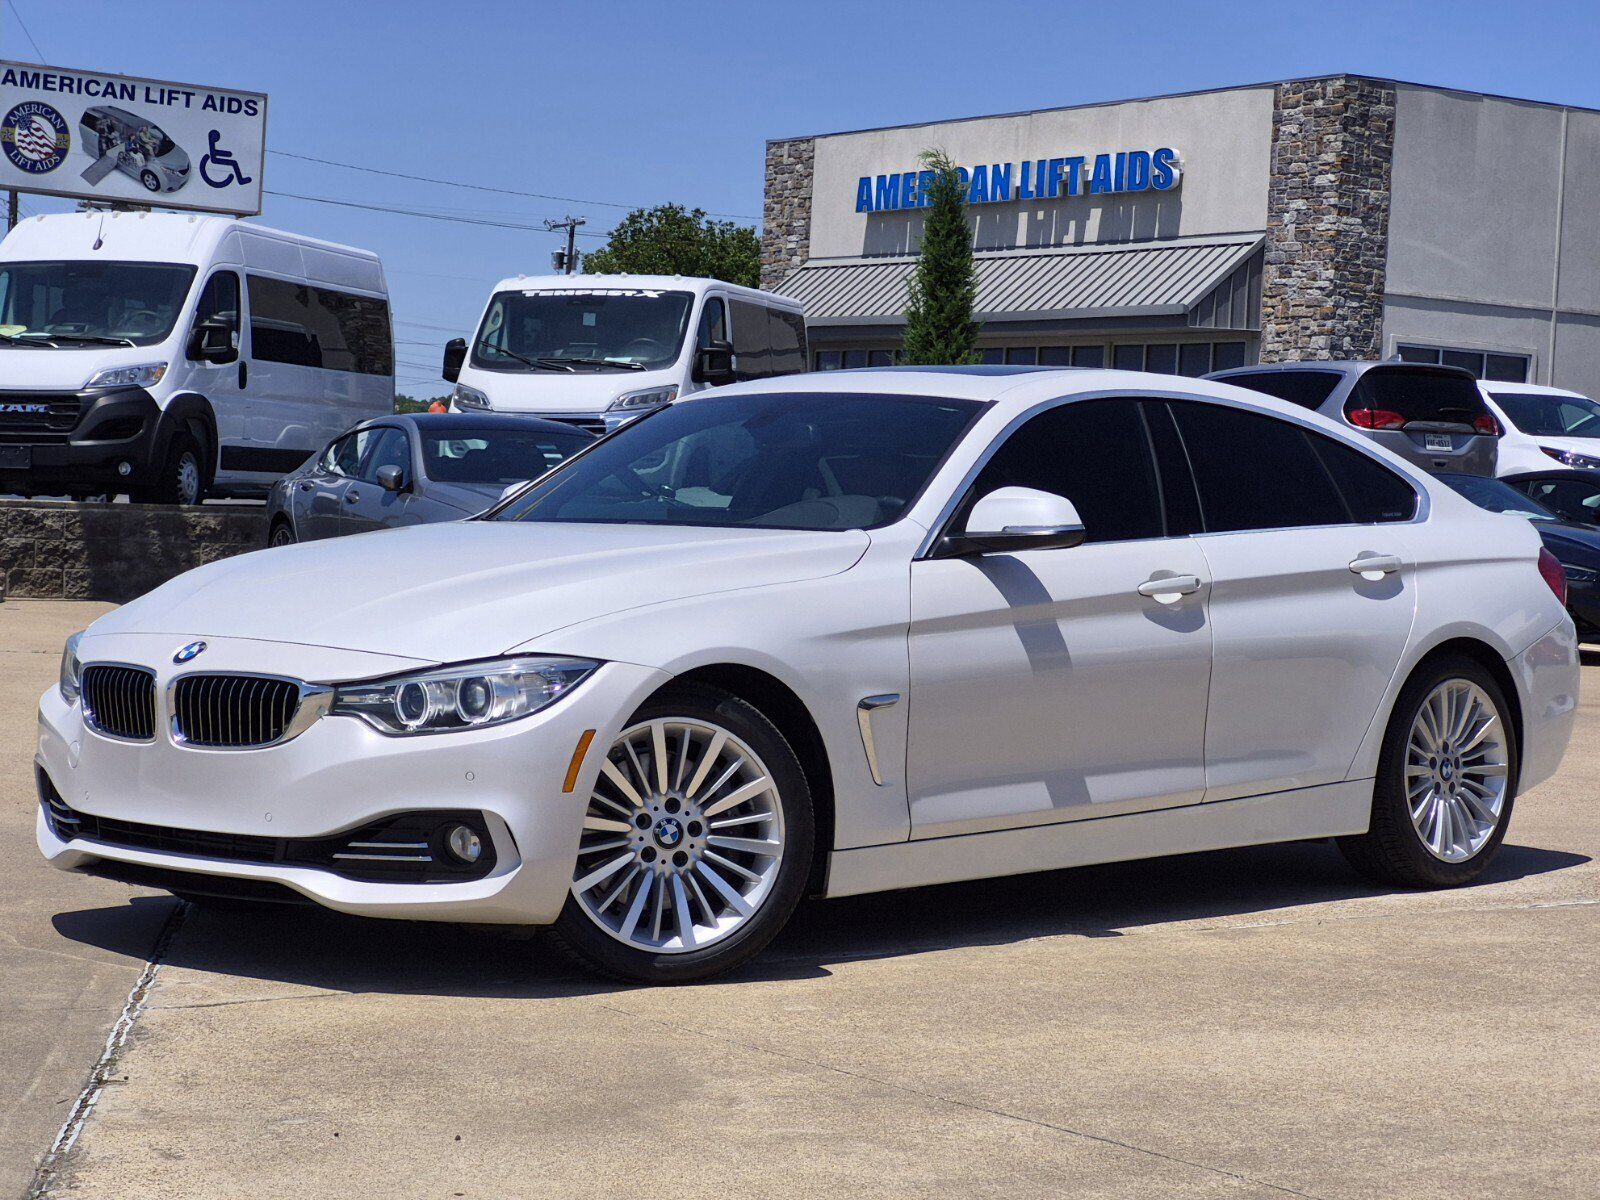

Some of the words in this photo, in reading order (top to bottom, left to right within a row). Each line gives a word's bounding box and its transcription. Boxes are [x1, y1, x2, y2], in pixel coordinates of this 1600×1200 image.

[1, 68, 136, 102] AMERICAN
[144, 86, 196, 109] LIFT
[201, 94, 259, 117] AIDS
[9, 104, 64, 129] AMERICAN
[10, 149, 33, 170] LIFT
[35, 154, 60, 171] AIDS
[855, 162, 1012, 213] AMERCAN
[1019, 155, 1085, 200] LIFT
[1089, 147, 1180, 195] AIDS
